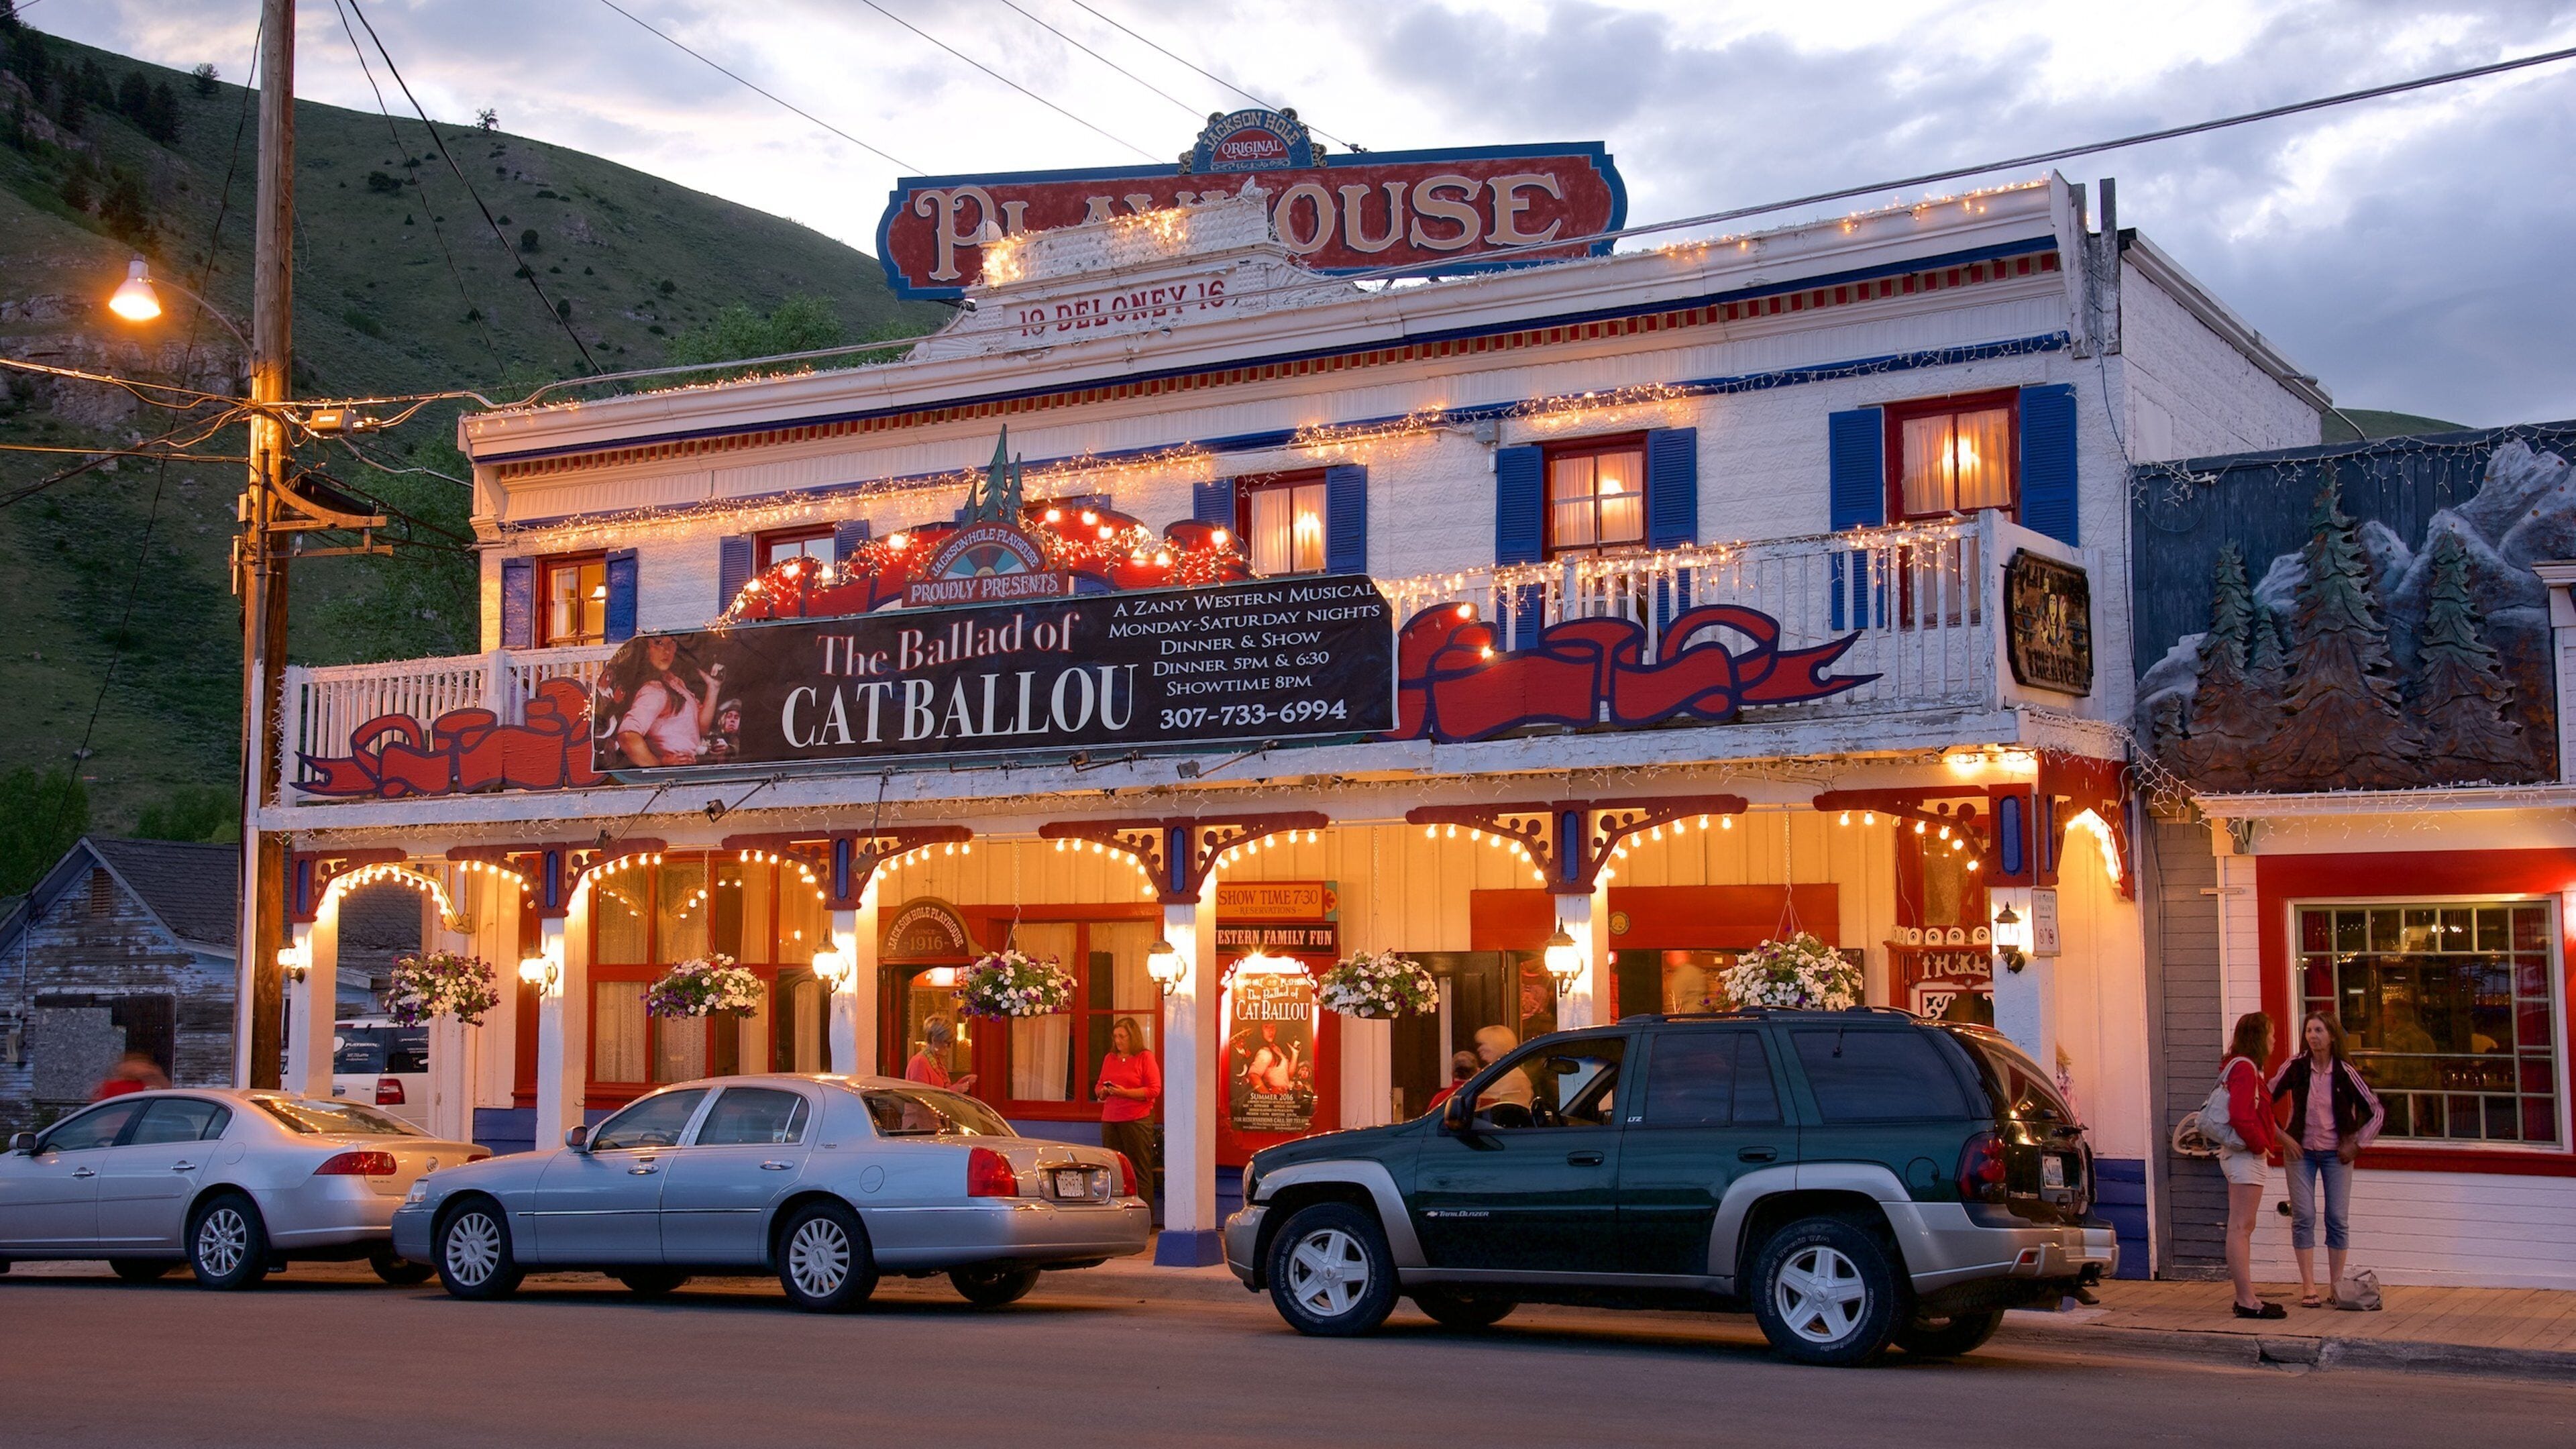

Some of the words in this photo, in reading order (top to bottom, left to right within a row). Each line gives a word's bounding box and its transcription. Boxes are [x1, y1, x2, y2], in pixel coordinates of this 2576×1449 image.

[1203, 111, 1263, 152] JACKSON
[1265, 113, 1300, 146] HOLE
[1222, 140, 1283, 159] ORIGINAL
[1056, 285, 1186, 331] DELONEY
[1198, 280, 1224, 309] 16
[931, 535, 972, 576] JACKSON
[967, 528, 996, 545] HOLE
[997, 529, 1039, 568] PLAYHOUSE
[911, 580, 978, 603] PROUDLY
[981, 574, 1058, 598] PRESENTS
[1114, 603, 1129, 617] A
[1134, 600, 1187, 616] ZANY
[1194, 590, 1282, 610] WESTERN
[1288, 584, 1376, 603] MUSICAL
[1108, 612, 1301, 638] MONDAY-SATURDAY
[1307, 604, 1381, 623] NIGHTS
[816, 635, 888, 676] The
[898, 614, 1024, 671] Ballad
[1032, 611, 1081, 653] of
[1160, 636, 1235, 655] DINNER
[1241, 635, 1256, 649] &
[1260, 631, 1322, 647] SHOW
[1153, 658, 1228, 676] DINNER
[1233, 656, 1269, 671] 5PM
[1275, 654, 1290, 667] &
[1296, 651, 1330, 665] 6:30
[1166, 677, 1270, 697] SHOWTIME
[1275, 675, 1313, 689] 8PM
[1160, 698, 1347, 730] 307-733-6994
[1218, 890, 1257, 906] SHOW
[1260, 890, 1291, 905] TIME
[1293, 890, 1318, 905] 7:30
[1240, 907, 1297, 915] RESERVATIONS
[888, 914, 914, 950] JACKSON
[910, 907, 930, 921] HOLE
[930, 908, 964, 948] PLAYHOUSE
[1216, 930, 1260, 945] ESTERN
[1264, 930, 1305, 945] FAMILY
[1309, 930, 1332, 945] FUN
[910, 936, 943, 951] 1916
[1246, 987, 1261, 1000] The
[1263, 985, 1289, 1000] Ballad
[1290, 987, 1299, 1000] of
[1279, 1093, 1293, 1101] 2016
